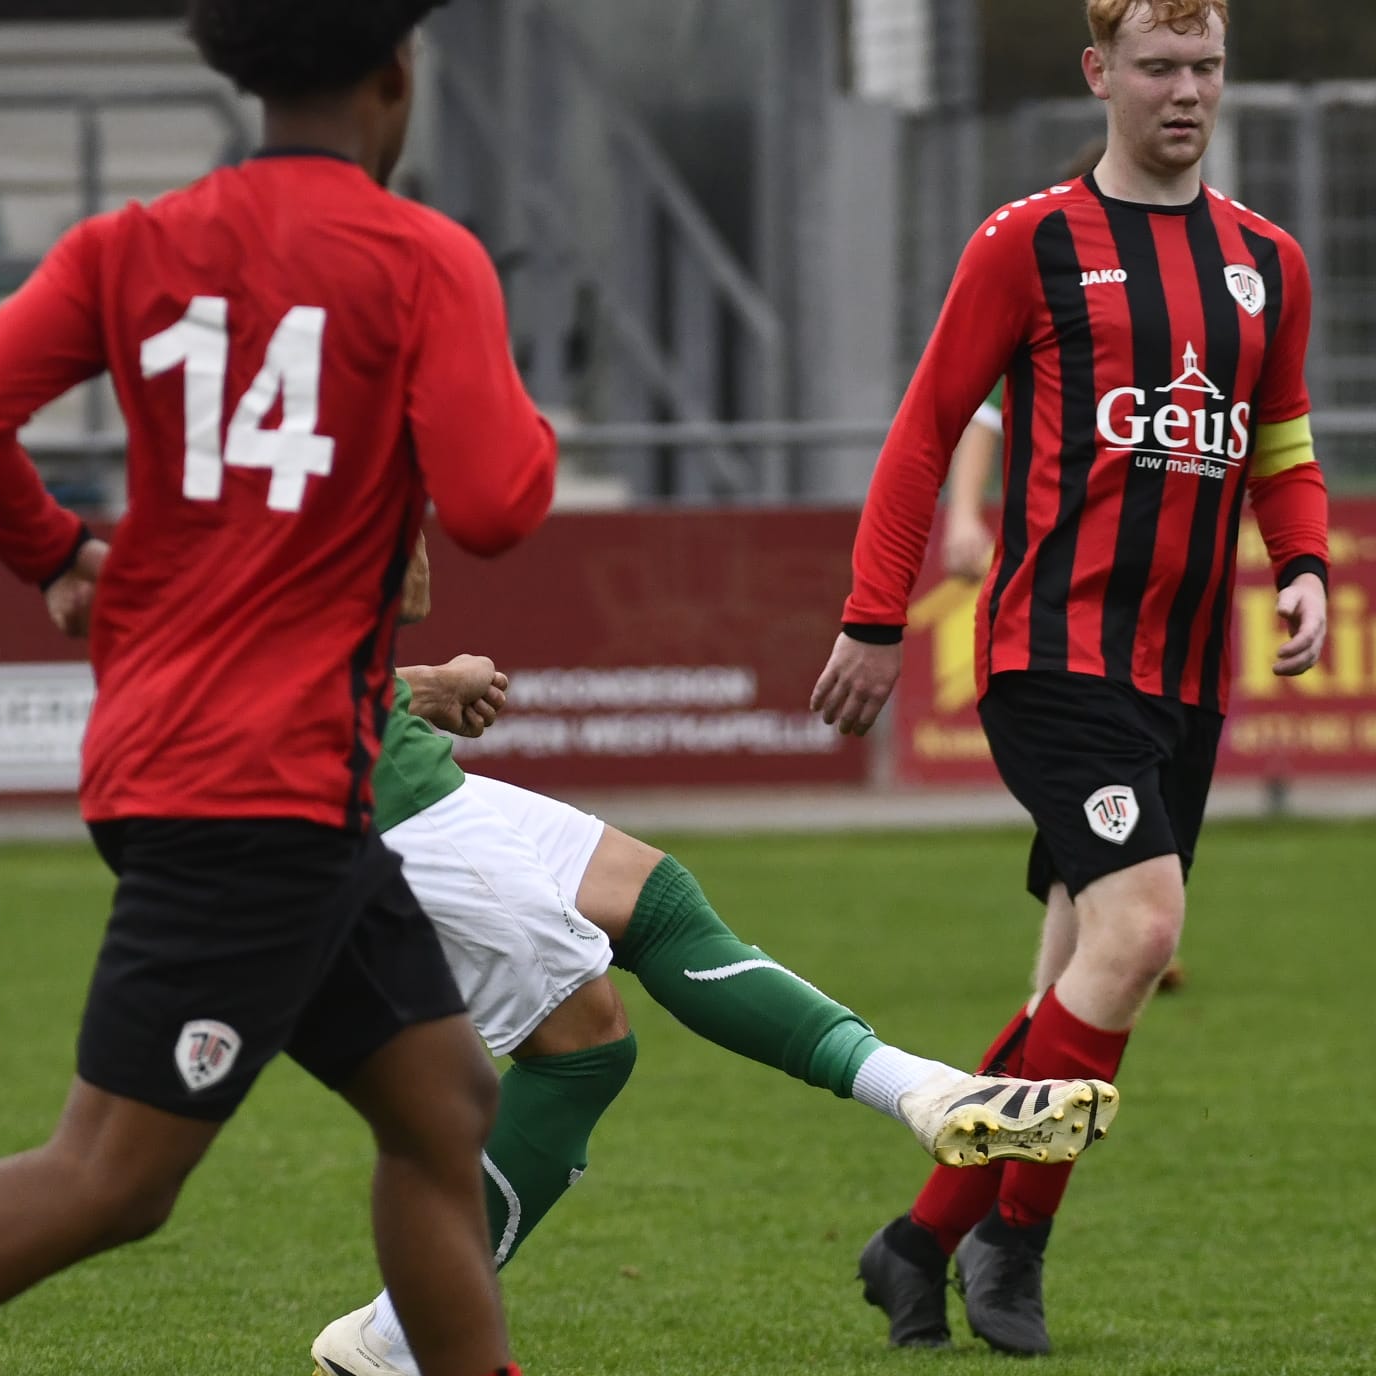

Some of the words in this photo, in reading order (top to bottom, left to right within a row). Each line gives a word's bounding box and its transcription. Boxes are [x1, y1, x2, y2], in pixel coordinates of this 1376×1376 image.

[1079, 268, 1128, 287] JAKO
[140, 295, 336, 513] 14
[1135, 454, 1162, 470] uw
[1165, 459, 1226, 480] makelaar
